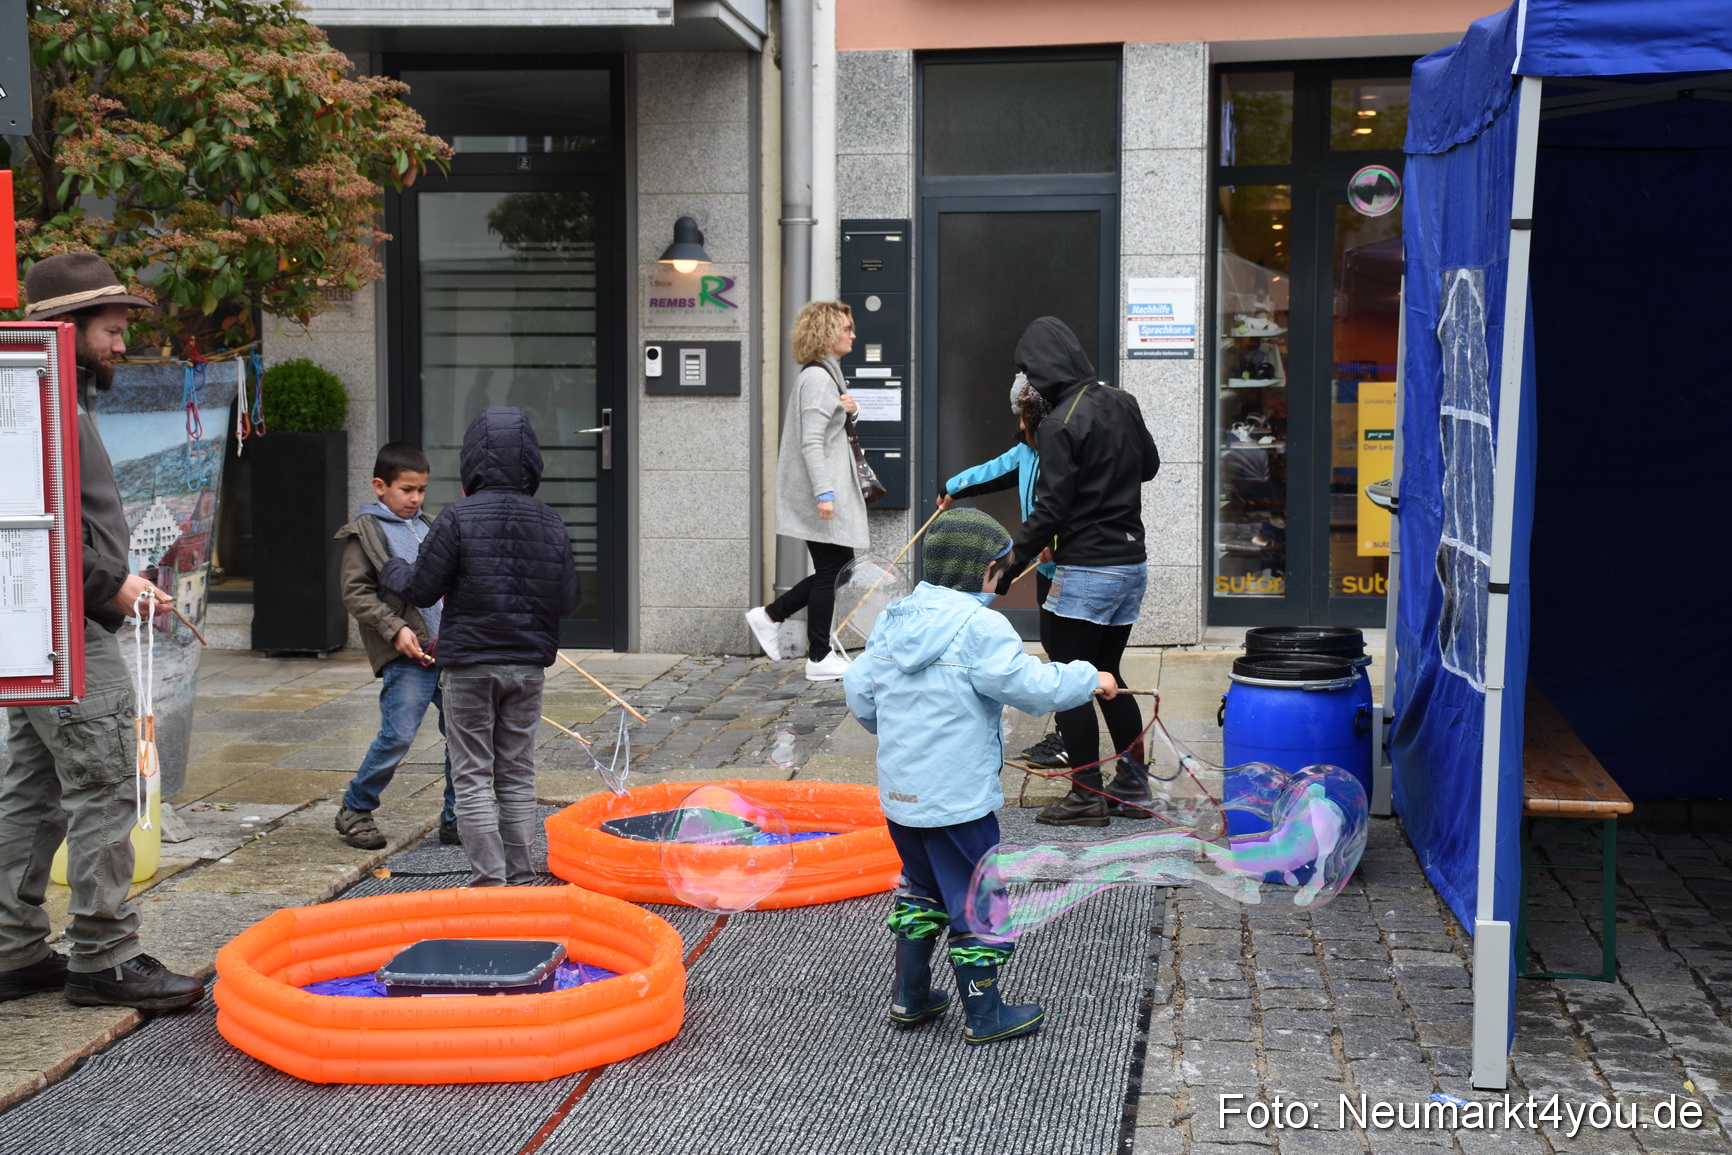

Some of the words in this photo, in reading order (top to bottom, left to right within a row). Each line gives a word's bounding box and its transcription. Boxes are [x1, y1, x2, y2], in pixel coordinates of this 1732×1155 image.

[649, 298, 696, 308] REMBS
[1132, 305, 1171, 315] Nachhilfe
[1141, 325, 1191, 336] Sprachkurse
